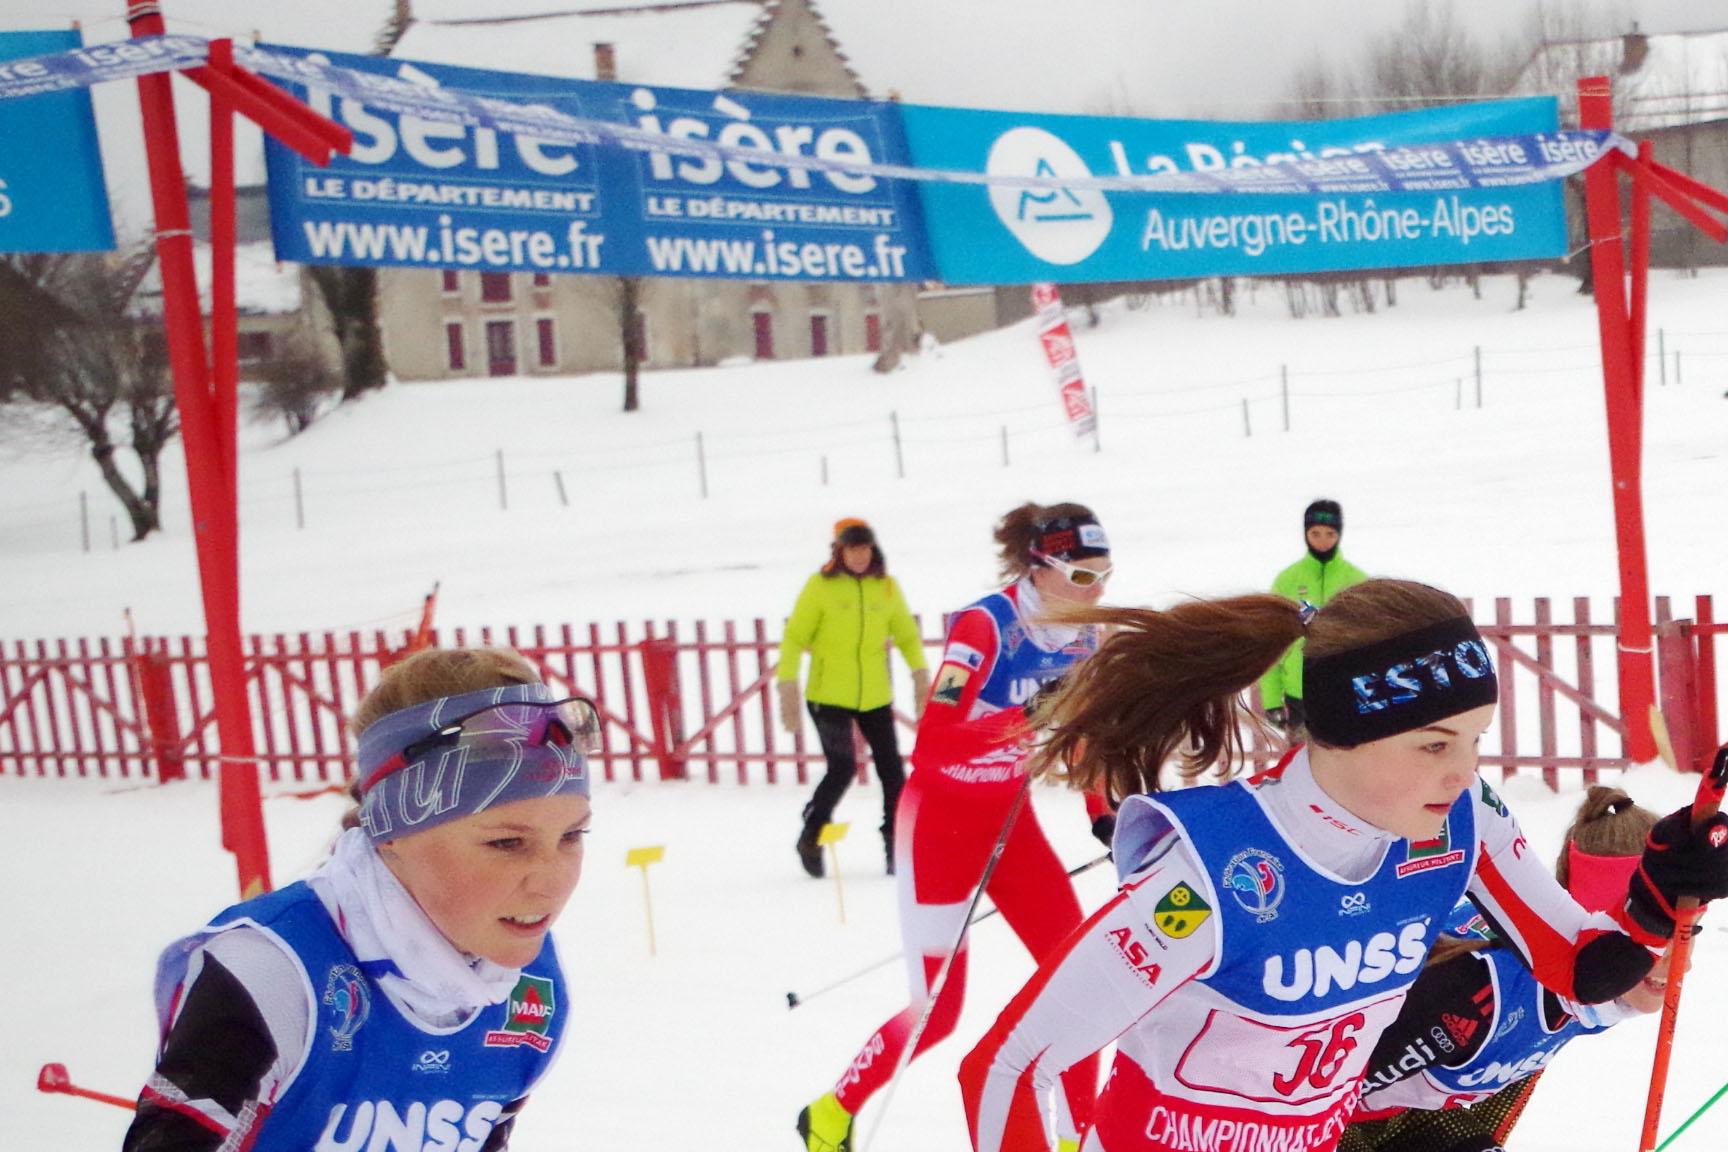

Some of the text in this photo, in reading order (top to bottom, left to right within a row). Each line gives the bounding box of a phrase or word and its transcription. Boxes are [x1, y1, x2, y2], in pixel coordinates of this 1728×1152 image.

[631, 88, 878, 195] isère
[1457, 140, 1528, 167] isère
[306, 177, 596, 212] LE DÉPARTEMENT
[647, 196, 895, 226] LE DÉPARTEMENT
[303, 214, 606, 269] www.isere.fr
[1143, 195, 1515, 256] Auvergne-Rhône-Alpes
[646, 229, 908, 279] www.isere.fr
[1352, 640, 1493, 714] ESTO
[1109, 926, 1163, 986] ASA
[1262, 917, 1428, 1002] UNSS
[511, 1000, 553, 1018] MAIF
[1361, 1038, 1437, 1096] Audi
